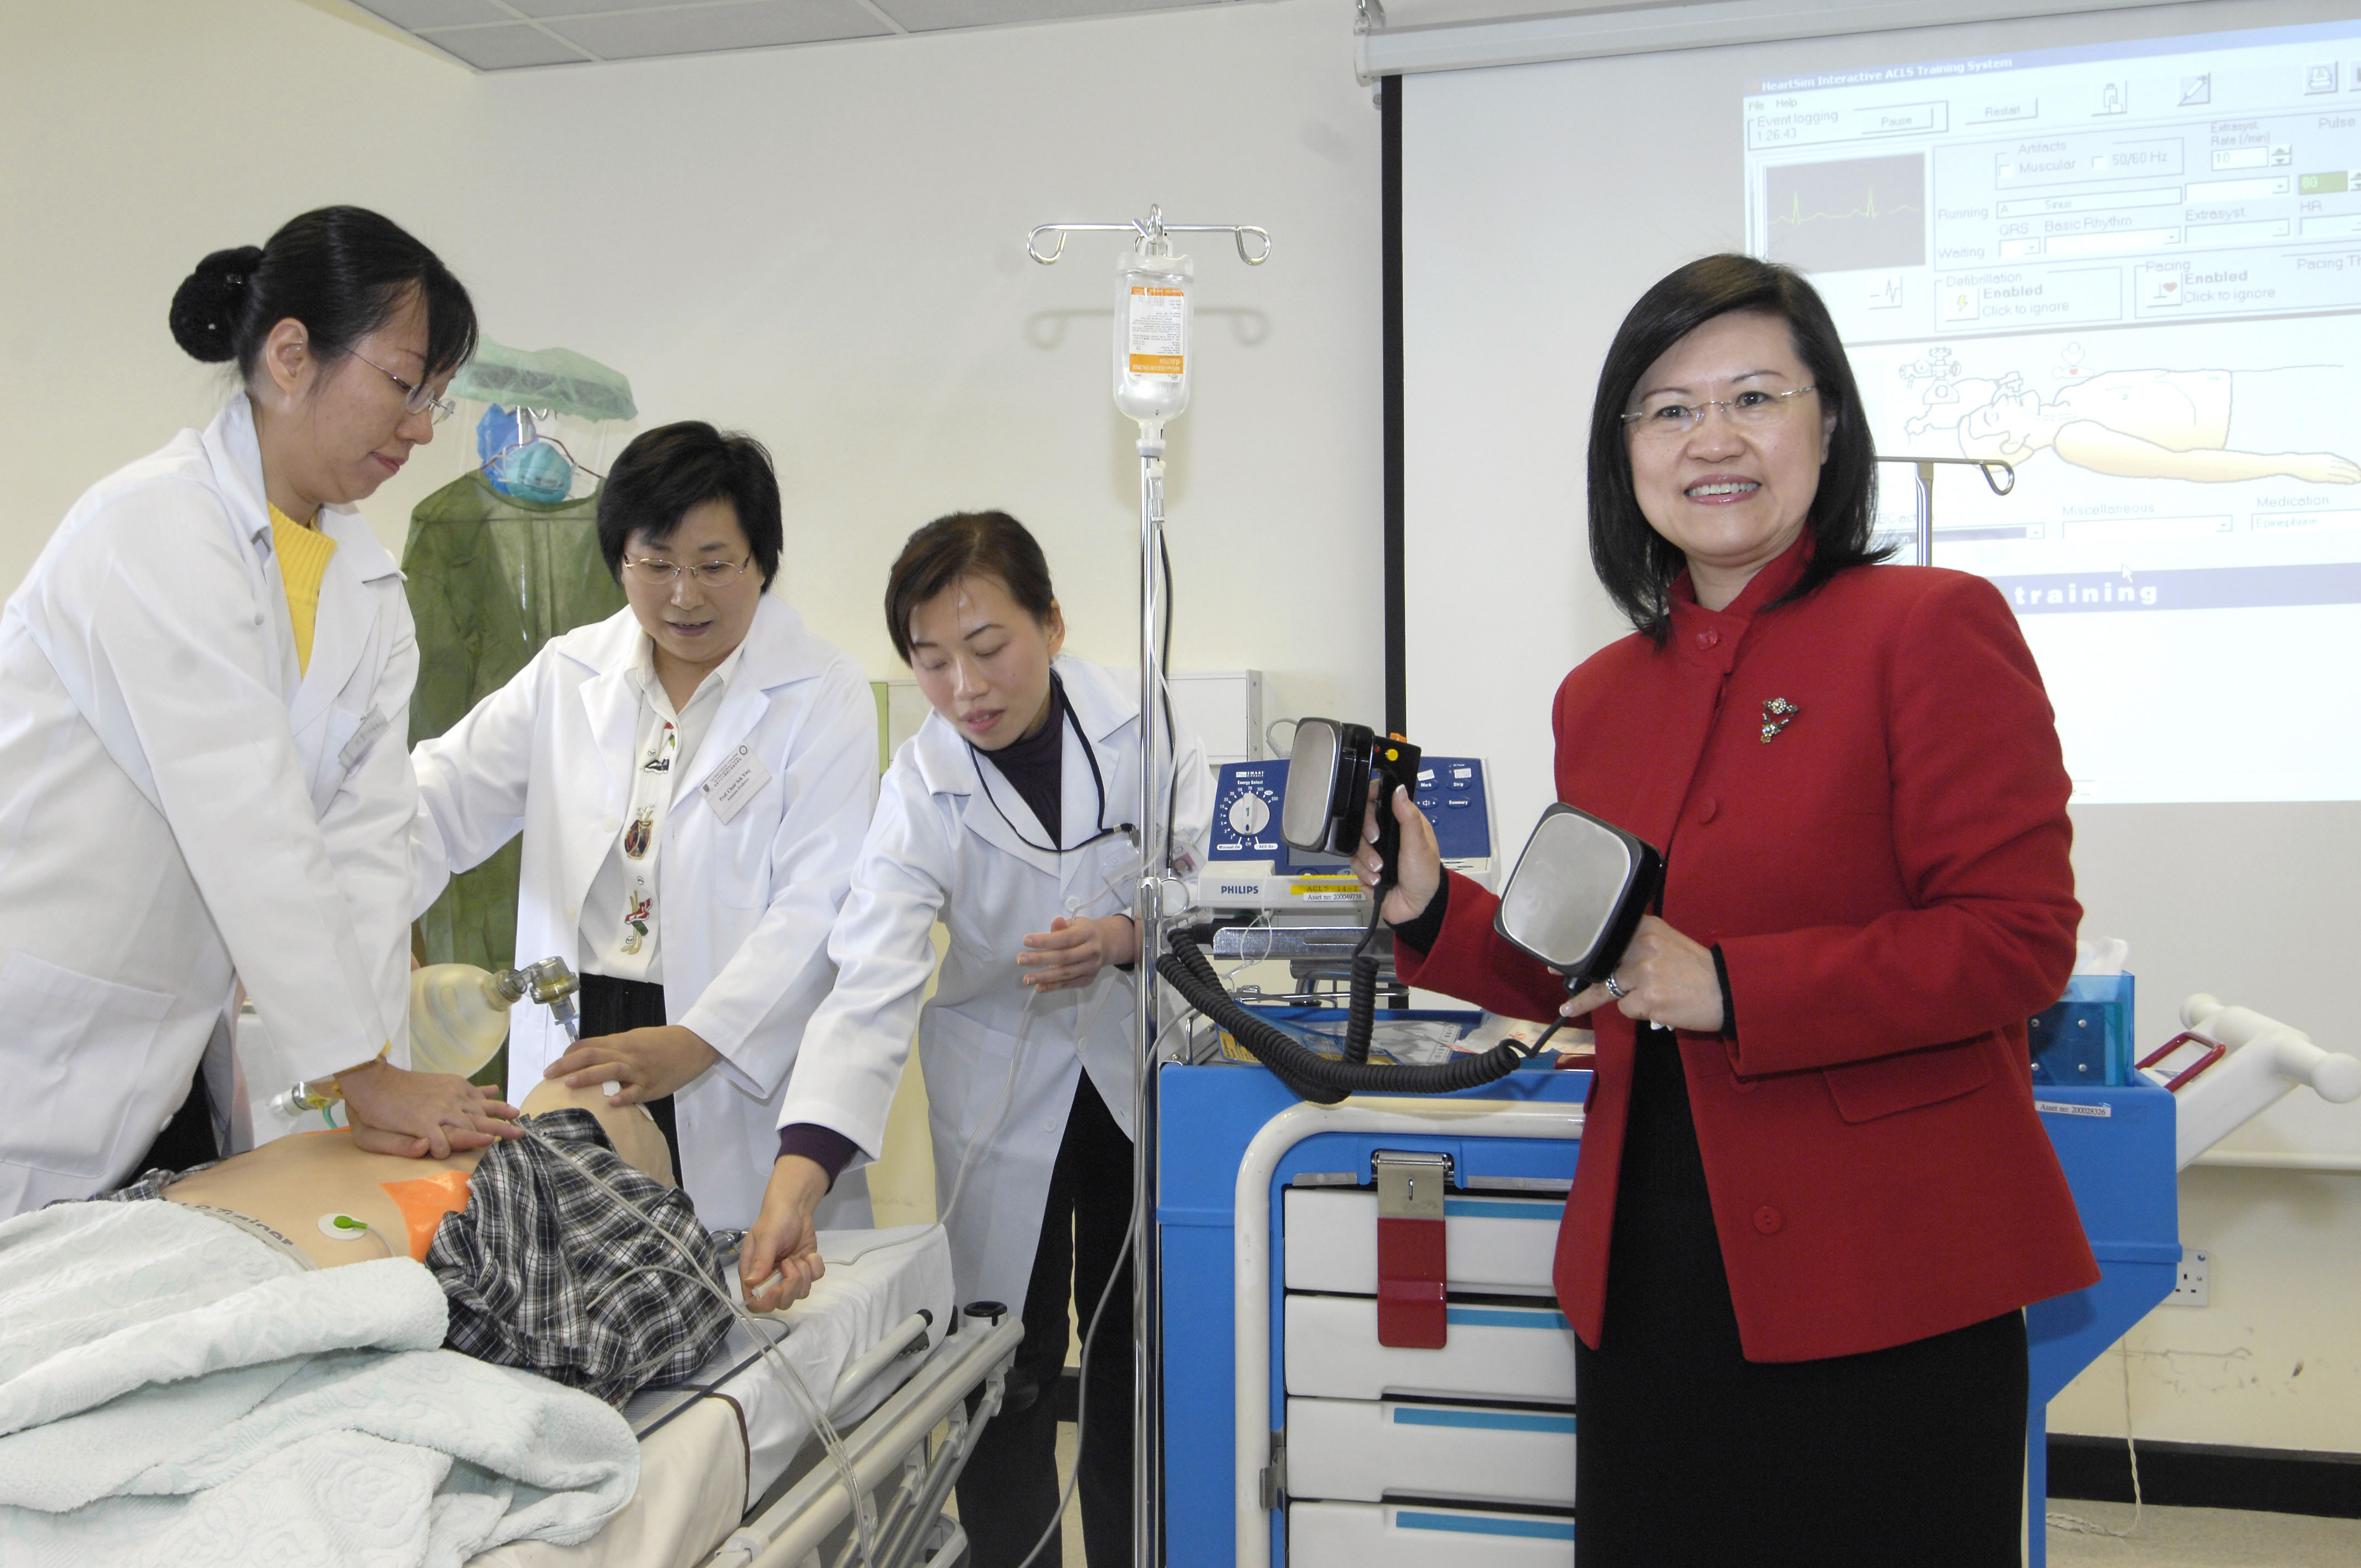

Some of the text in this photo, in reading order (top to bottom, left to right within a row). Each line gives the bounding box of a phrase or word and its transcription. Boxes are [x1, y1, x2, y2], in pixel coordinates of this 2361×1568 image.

[1761, 58, 2012, 92] HeartSim Interactive ACLS Training System
[1748, 97, 1797, 110] File Help
[1985, 105, 2021, 117] Restart
[1758, 110, 1839, 127] Event logging
[1881, 116, 1913, 127] Pause
[2318, 117, 2357, 129] Pulse
[1757, 129, 1797, 142] 1:26:43
[2211, 135, 2236, 146] Rate
[2017, 141, 2067, 155] Artifacts
[2019, 150, 2168, 173] Muscular 50/60 Hz
[2216, 153, 2231, 164] 10
[1938, 208, 1989, 221] Running
[2000, 204, 2009, 214] A
[2300, 200, 2322, 213] HR
[1999, 216, 2132, 236] QRS Basic Rhythm
[1938, 247, 1985, 260] Waiting
[2146, 260, 2191, 273] Pacing
[2297, 258, 2344, 271] Pacing
[1946, 273, 2022, 287] Defibrillation
[2185, 270, 2249, 285] Enabled
[1983, 284, 2043, 300] Enabled
[2183, 287, 2276, 303] Click to ignore
[1982, 301, 2069, 318] Click to ignore
[2256, 495, 2330, 508] Medication
[2062, 503, 2155, 516] Miscellaneous
[2014, 581, 2158, 605] training
[1245, 807, 1249, 816] 1
[1221, 885, 1259, 894] PHILIPS
[2071, 1107, 2106, 1115] 200028326
[216, 1207, 293, 1246] Trainer
